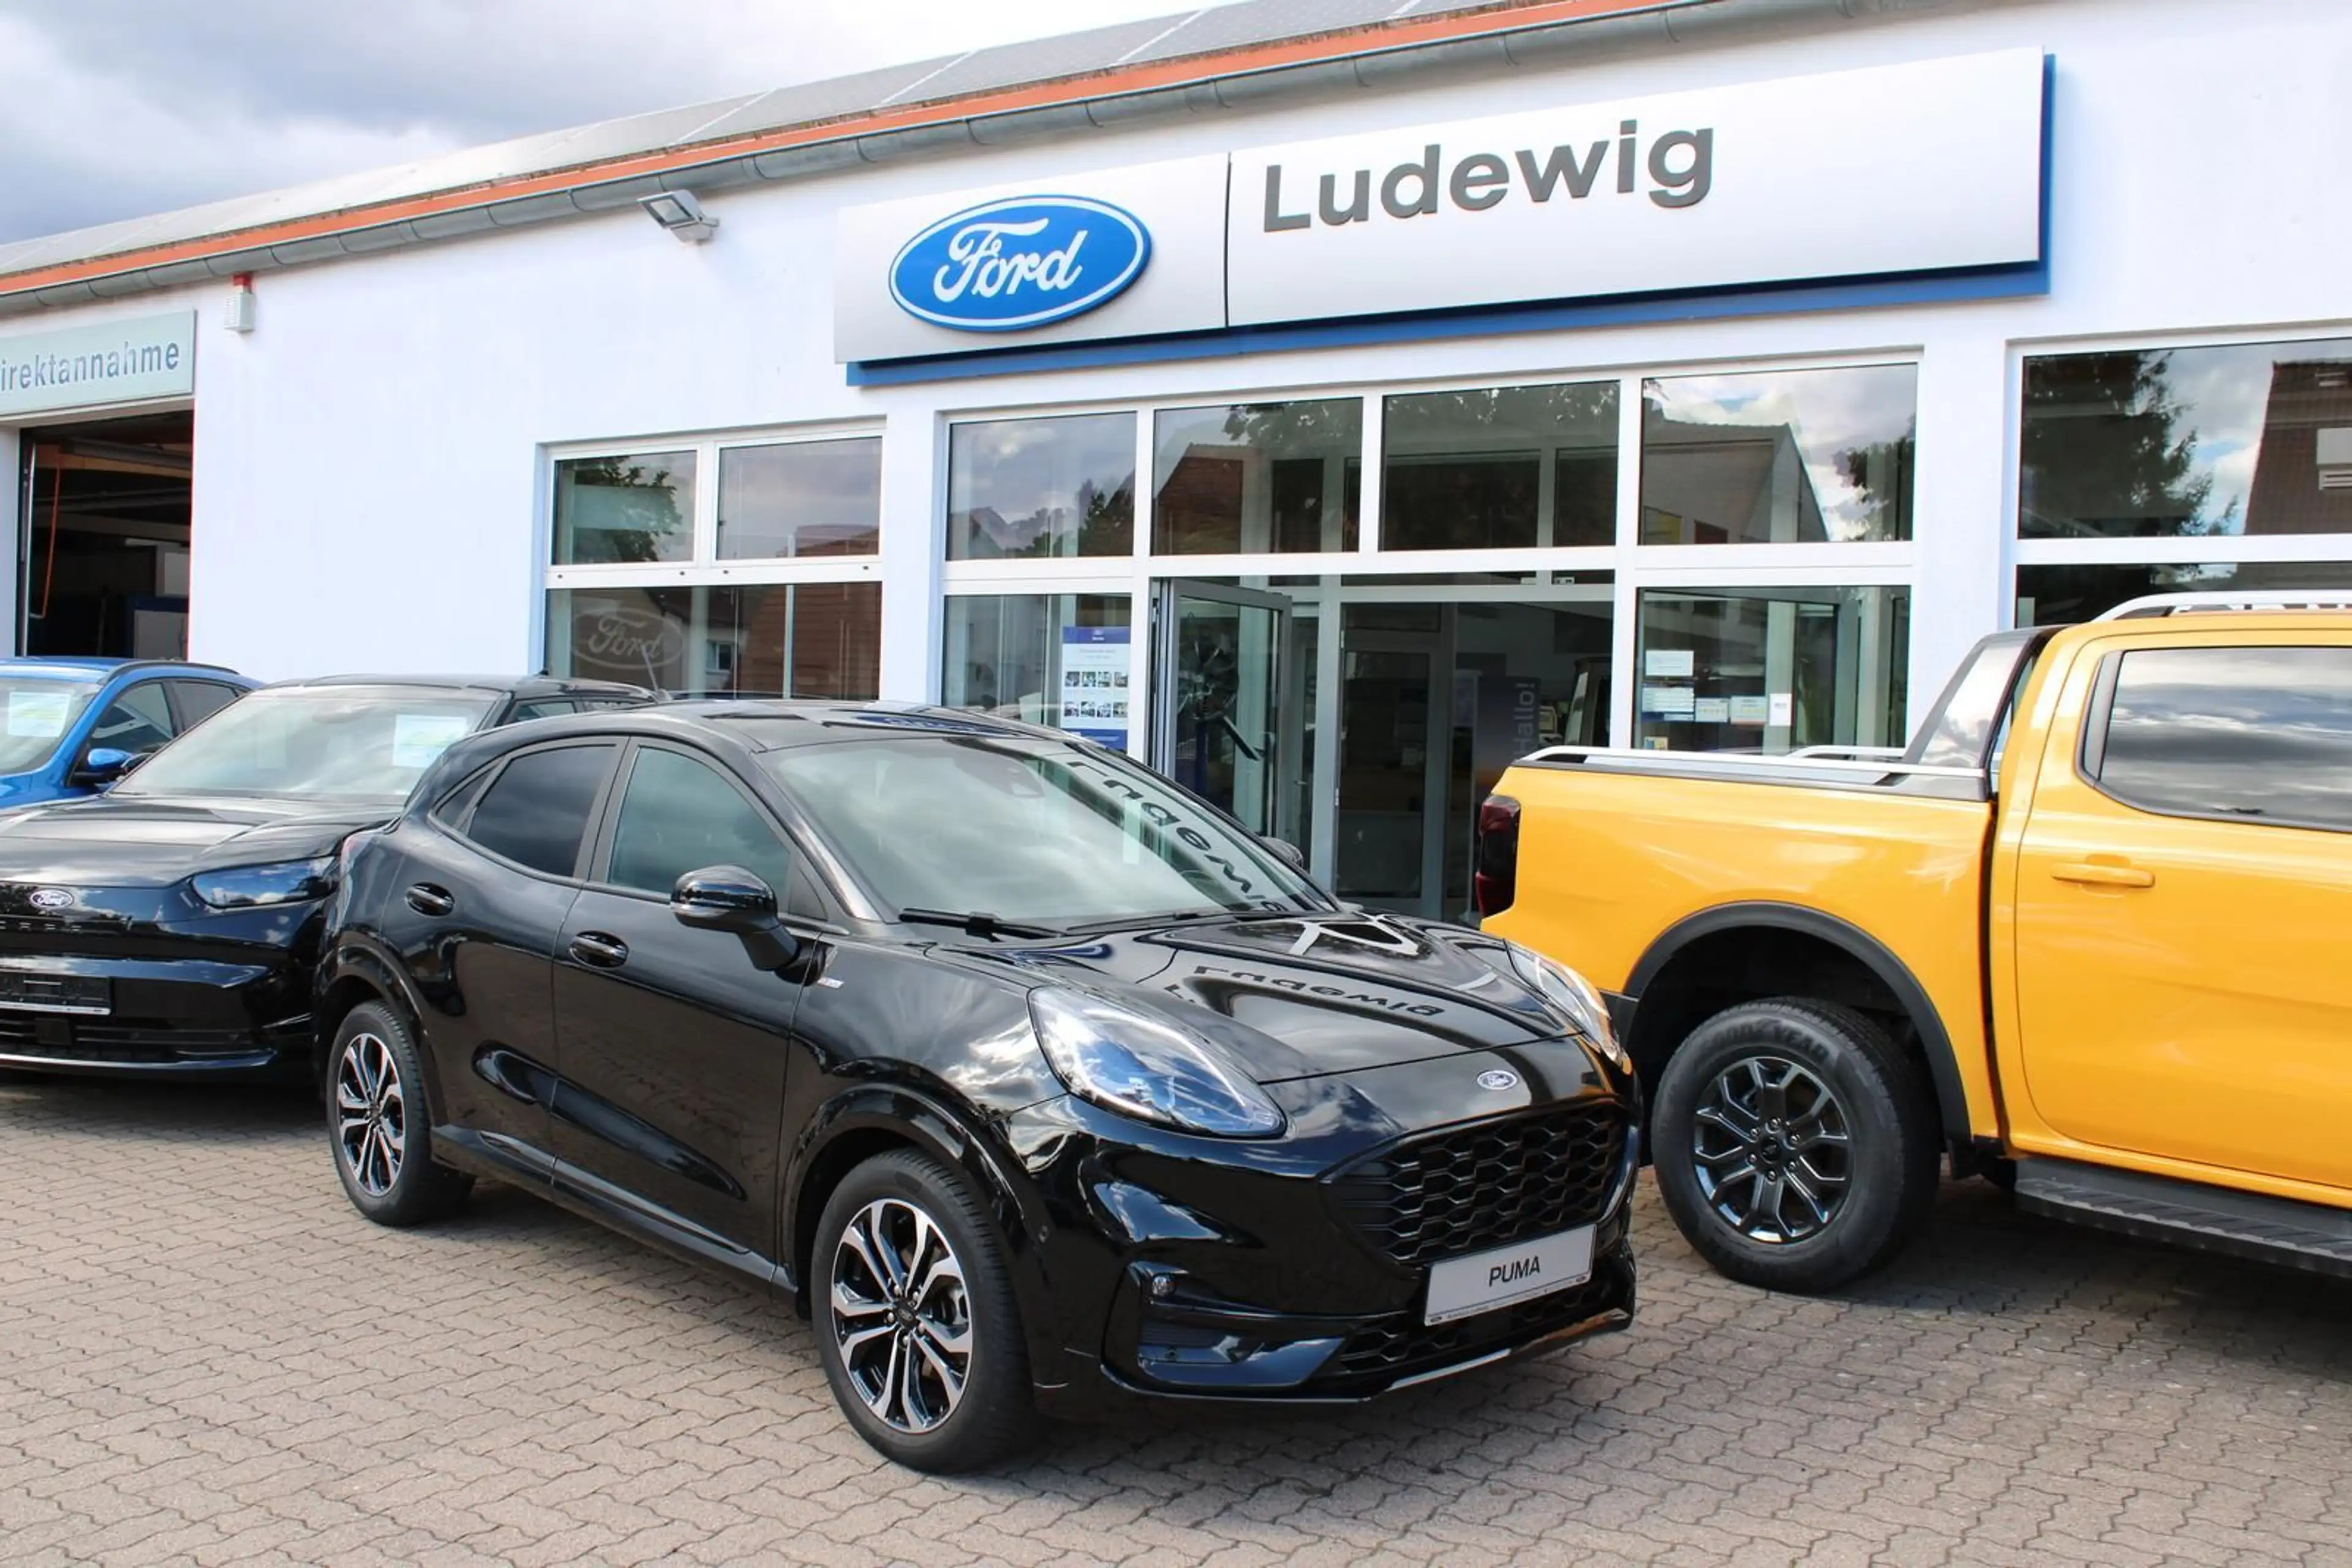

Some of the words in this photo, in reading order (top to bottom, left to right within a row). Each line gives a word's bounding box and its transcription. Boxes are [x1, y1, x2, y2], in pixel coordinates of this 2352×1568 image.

[1264, 118, 1714, 233] Ludewig
[933, 217, 1089, 303] Ford
[1, 341, 179, 391] irektannahme
[588, 614, 665, 660] Ford
[1513, 682, 1536, 755] Hallo!
[1489, 1256, 1540, 1287] PUMA
